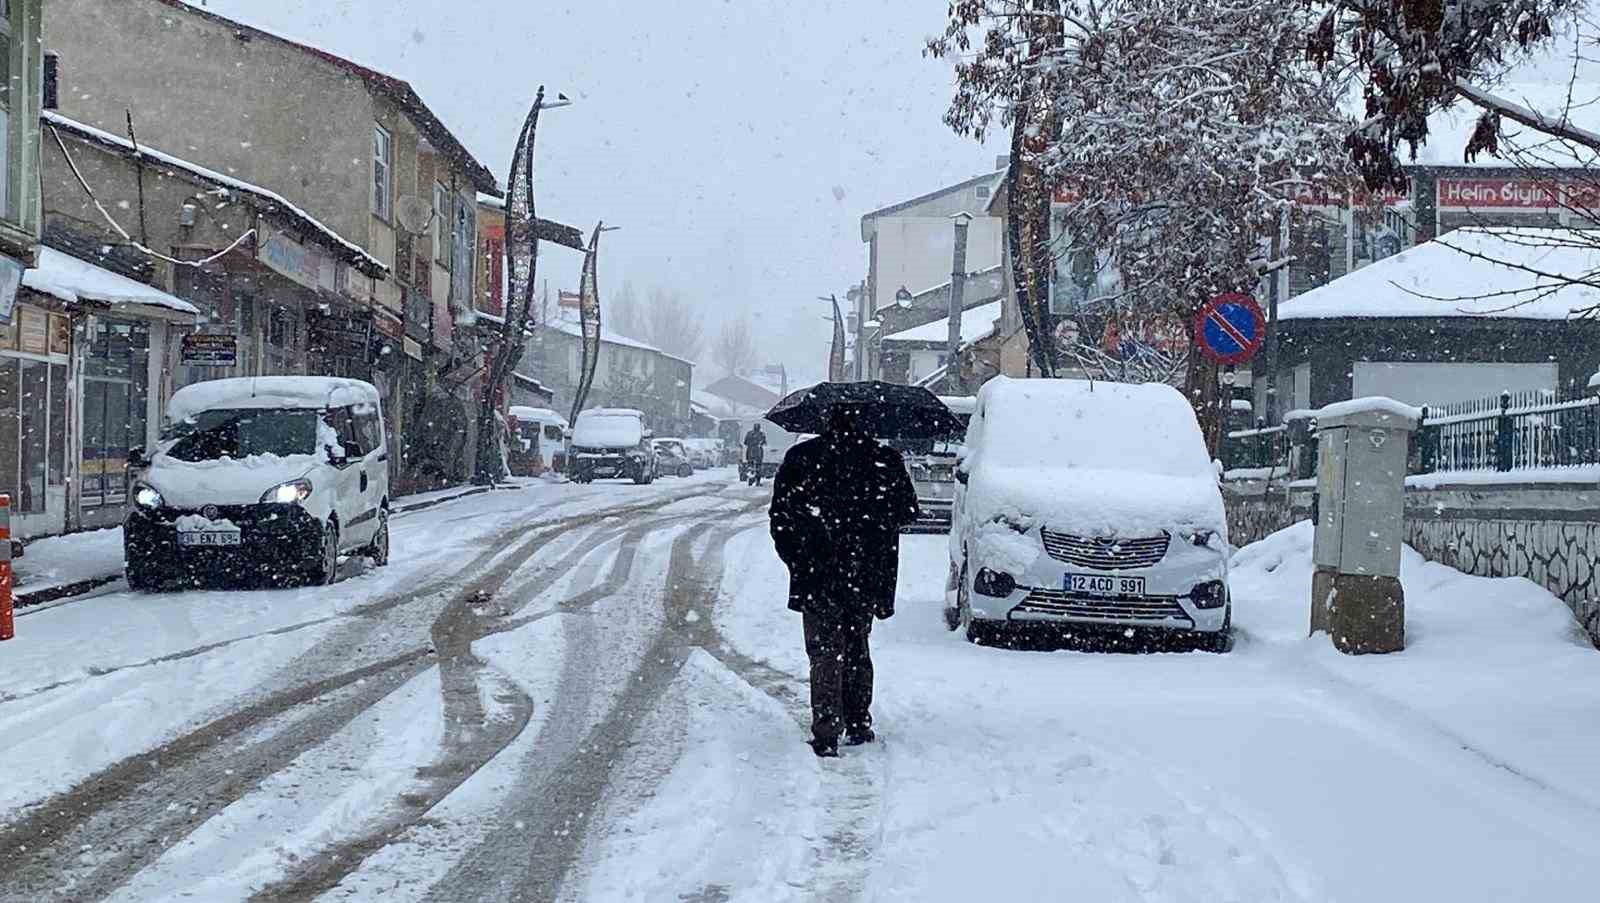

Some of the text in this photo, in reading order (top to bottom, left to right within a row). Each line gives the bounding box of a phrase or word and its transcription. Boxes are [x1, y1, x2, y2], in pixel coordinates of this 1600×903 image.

[1448, 183, 1497, 201] Helin
[1072, 576, 1086, 590] 12
[1120, 579, 1142, 593] 991
